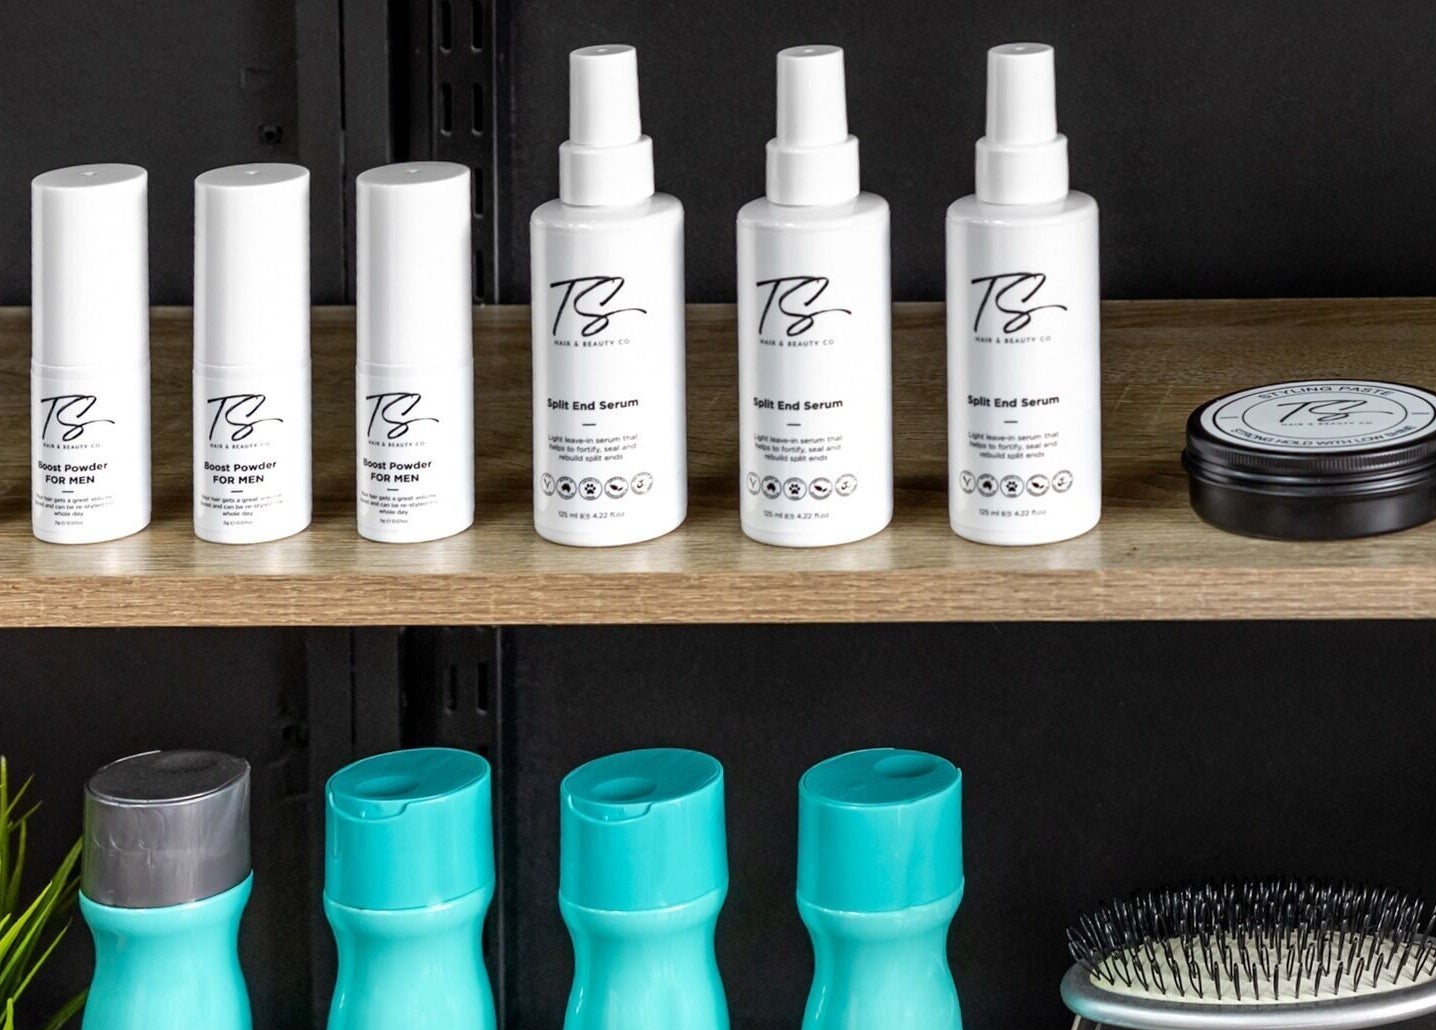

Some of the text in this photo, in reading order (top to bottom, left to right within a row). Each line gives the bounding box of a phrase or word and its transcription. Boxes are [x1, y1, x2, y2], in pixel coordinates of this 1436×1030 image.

[1257, 384, 1396, 400] STYLING PASTE
[547, 398, 639, 411] Split End Serum
[753, 397, 843, 411] Split End Serum
[967, 395, 1060, 408] Split End Serum
[38, 461, 108, 473] Boost Powder
[204, 460, 277, 473] Boost Powder
[363, 458, 432, 471] Boost Powder
[46, 474, 95, 485] FOR MEN
[213, 474, 265, 485] FOR MEN
[371, 473, 420, 484] FOR MEN
